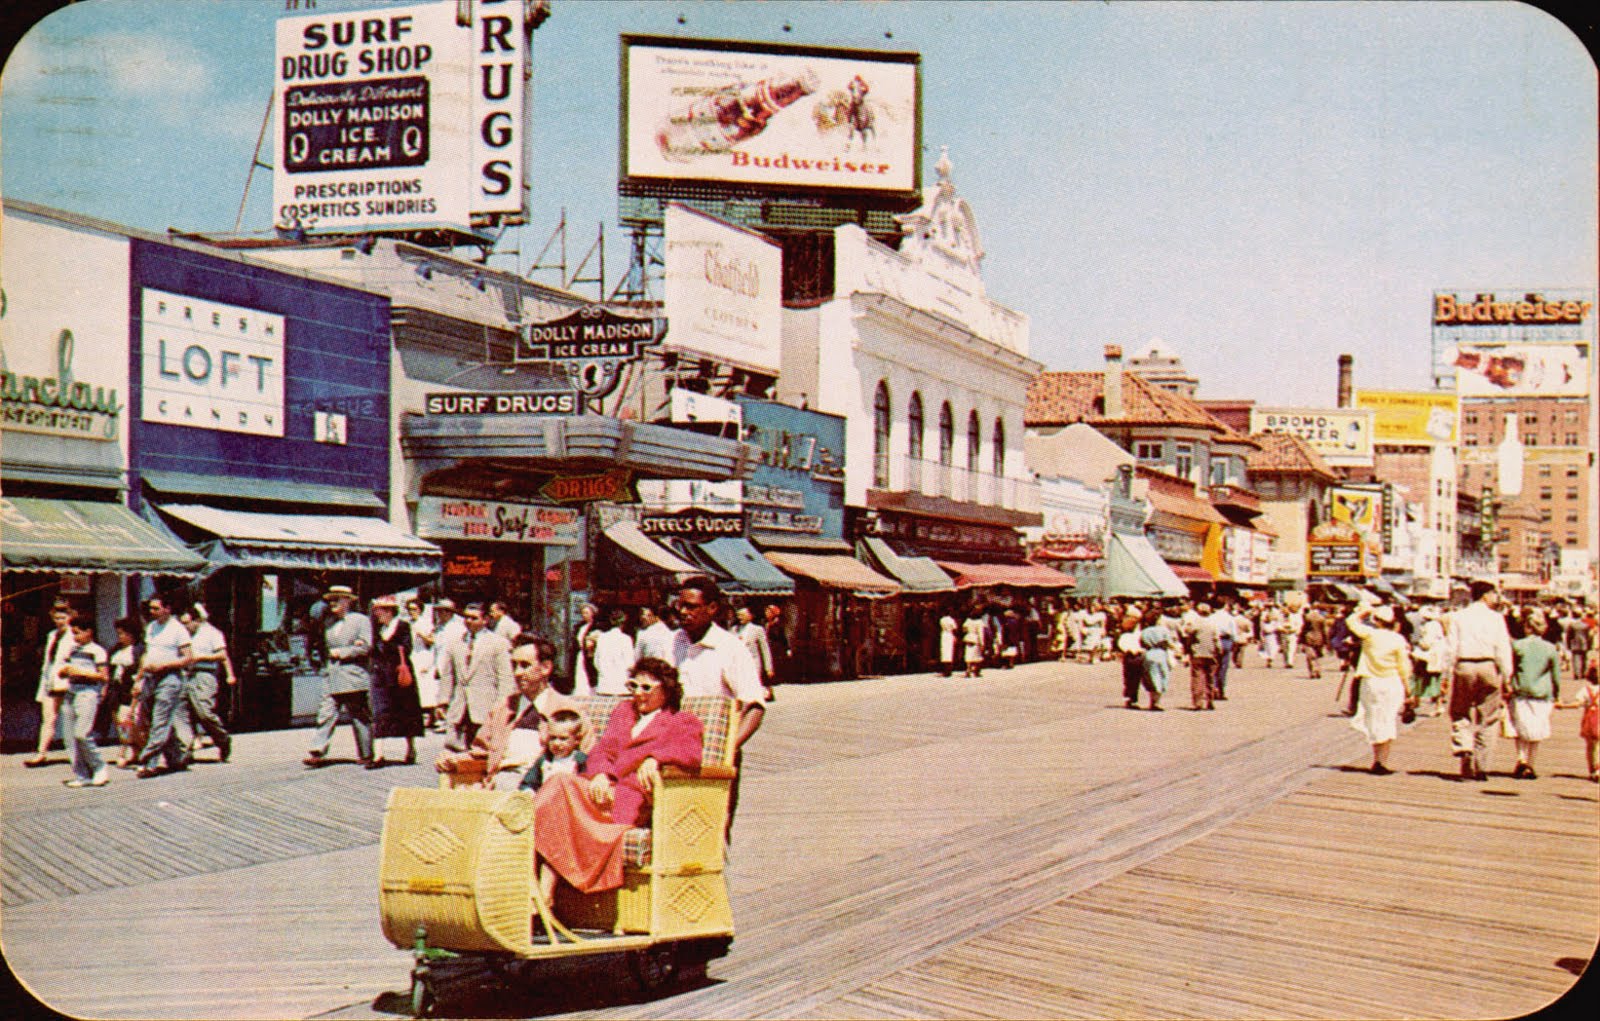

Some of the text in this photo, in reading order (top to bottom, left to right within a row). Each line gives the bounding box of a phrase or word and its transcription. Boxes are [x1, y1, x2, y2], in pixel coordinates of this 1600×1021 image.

[303, 16, 413, 49] SURF
[282, 45, 432, 80] DRUG SHOP
[481, 0, 515, 196] RUGS
[290, 104, 424, 127] DOLLY MADISON
[340, 127, 377, 143] ICE
[319, 147, 391, 164] CREAM
[730, 151, 890, 175] Budweiser
[294, 179, 423, 198] PRESCRIPTIONS
[280, 198, 437, 220] COSMETICS SUNDRIES
[158, 300, 275, 337] FRESH
[1435, 293, 1593, 323] Budweiser
[532, 322, 652, 341] DOLLY MADISON
[555, 343, 628, 357] ICE CREAM
[158, 339, 274, 392] LOFT
[0, 328, 124, 438] arclay
[158, 399, 275, 428] CANDY
[428, 395, 574, 414] SURF DRUGS
[555, 477, 617, 498] DRUGS
[492, 505, 530, 540] Surf
[643, 517, 694, 533] STEEL'S
[697, 517, 743, 534] FUDGE
